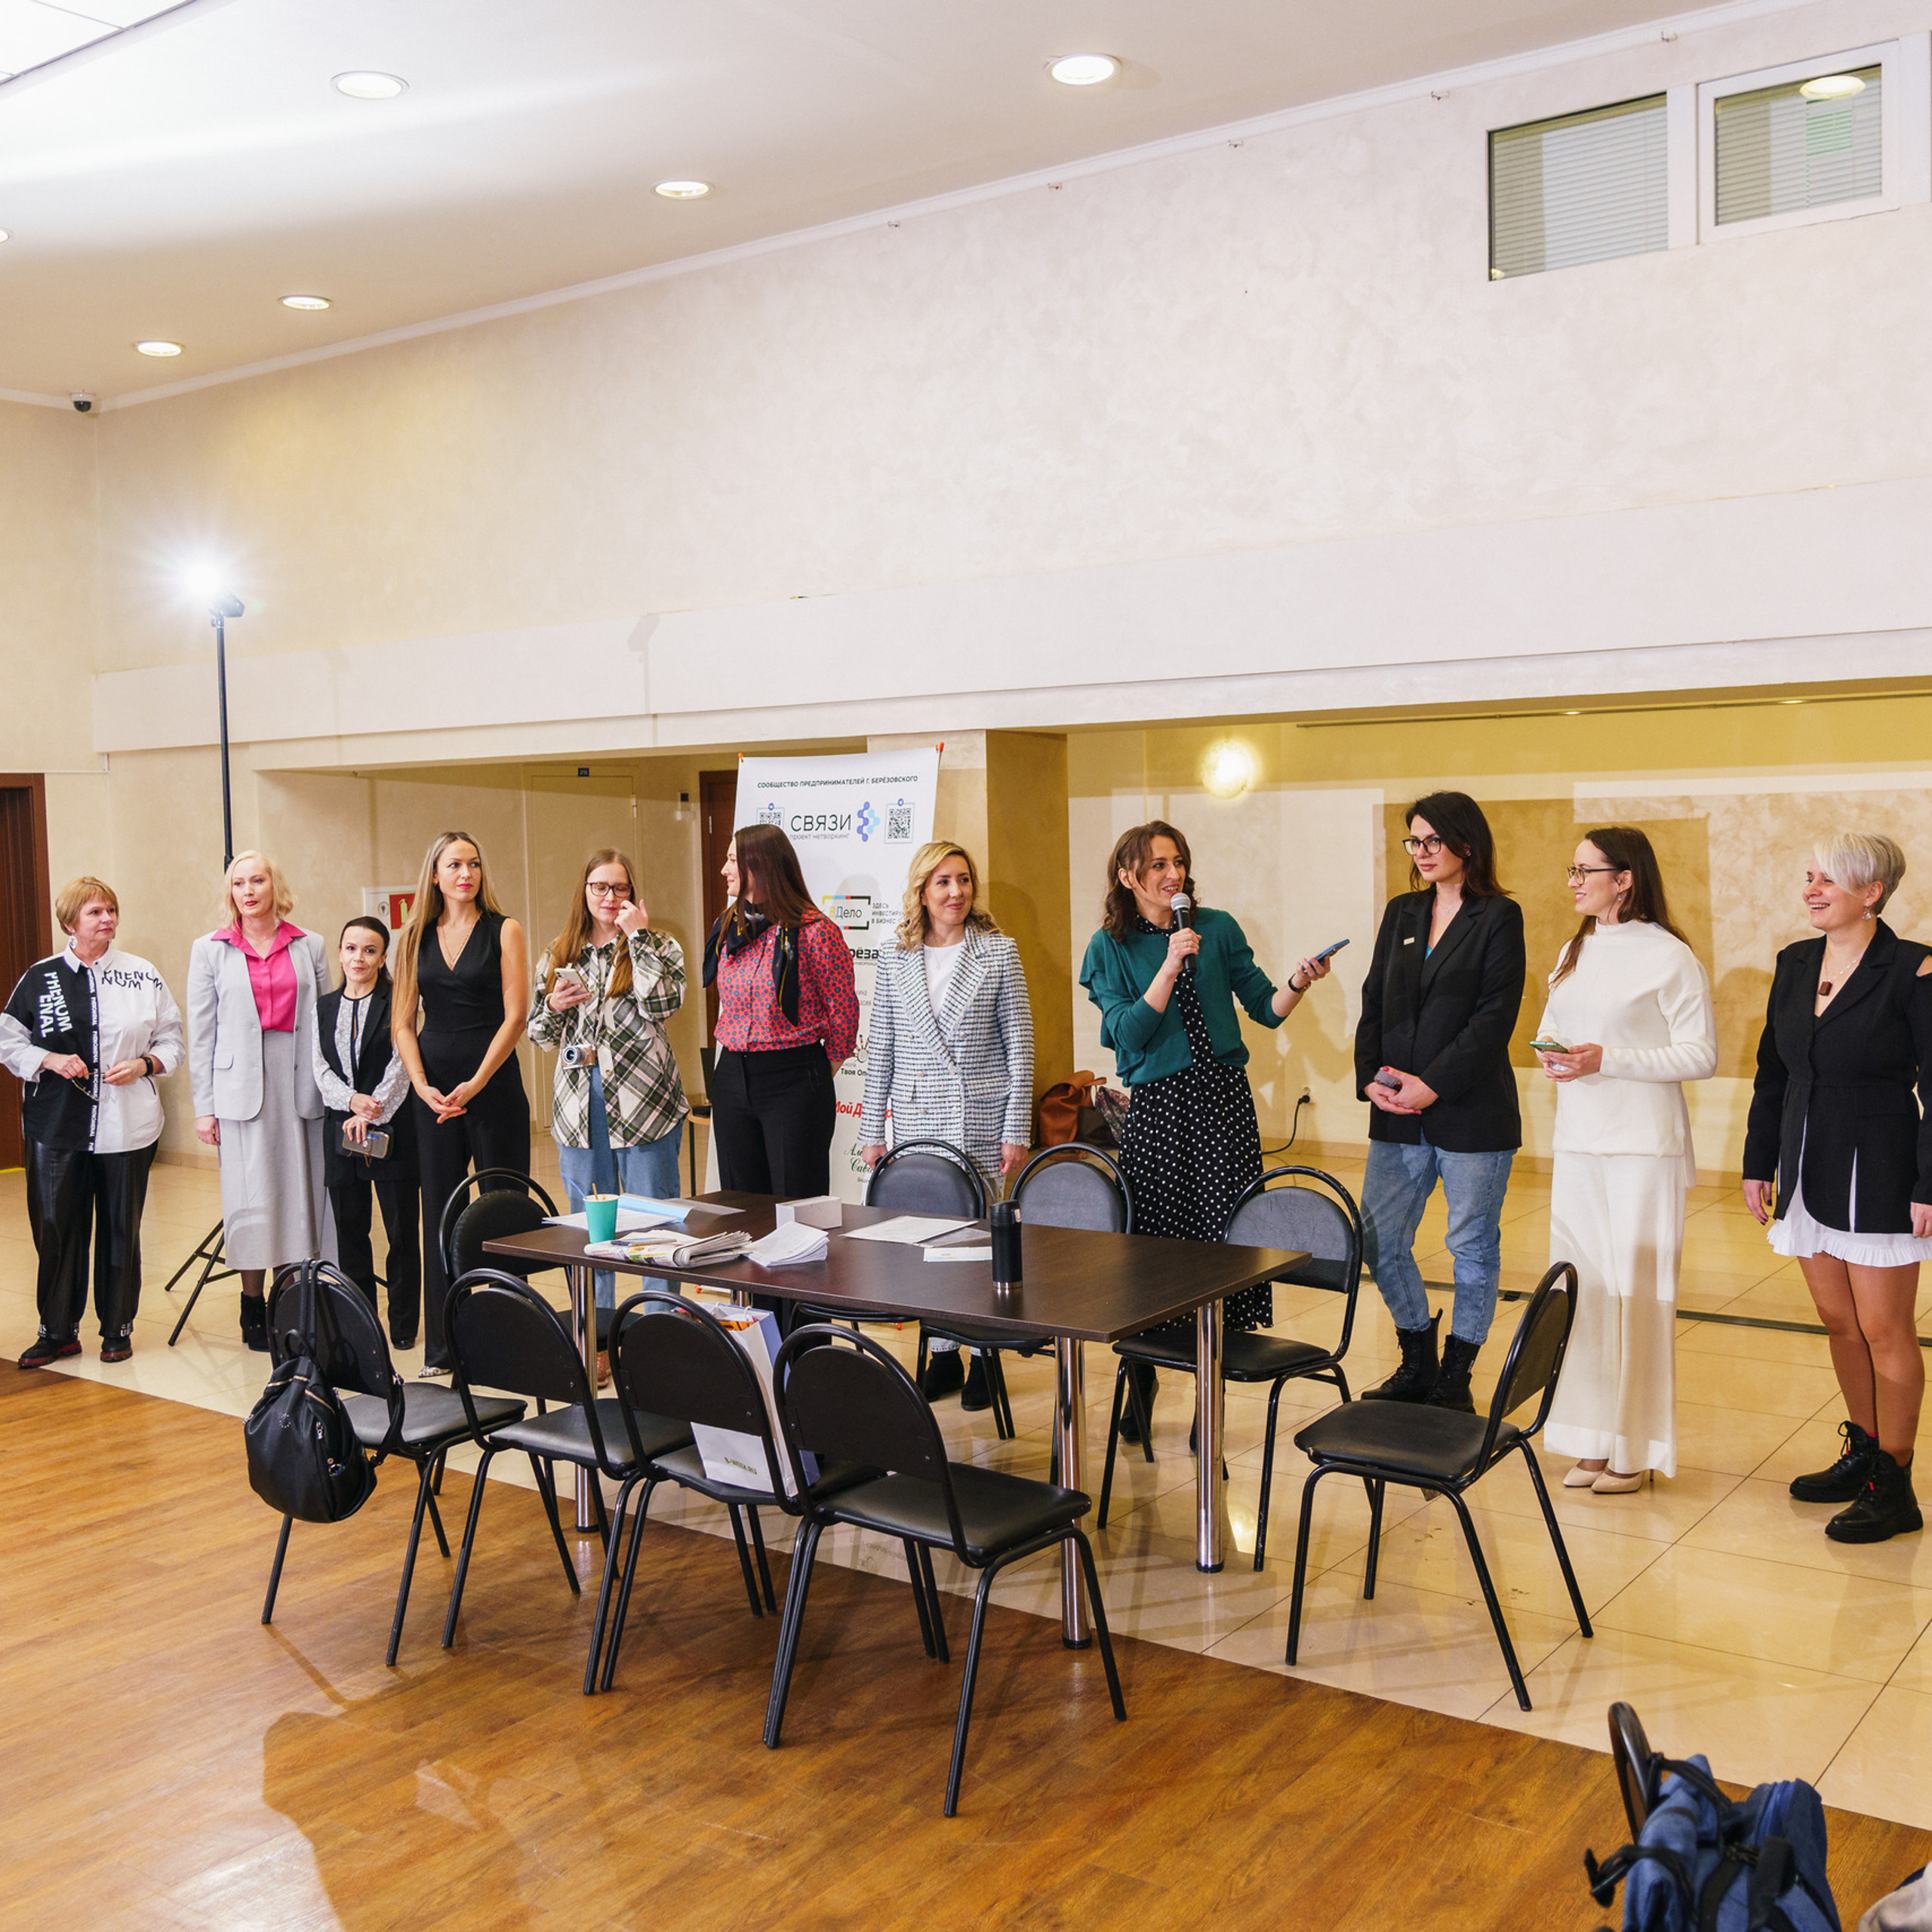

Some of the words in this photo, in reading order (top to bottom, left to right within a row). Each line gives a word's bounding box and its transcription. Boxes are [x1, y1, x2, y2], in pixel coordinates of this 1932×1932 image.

[800, 778, 865, 787] ПРЕДПРИНИМАТЕЛЕЙ
[790, 814, 851, 832] СВЯЗИ
[39, 993, 54, 1038] ENAL
